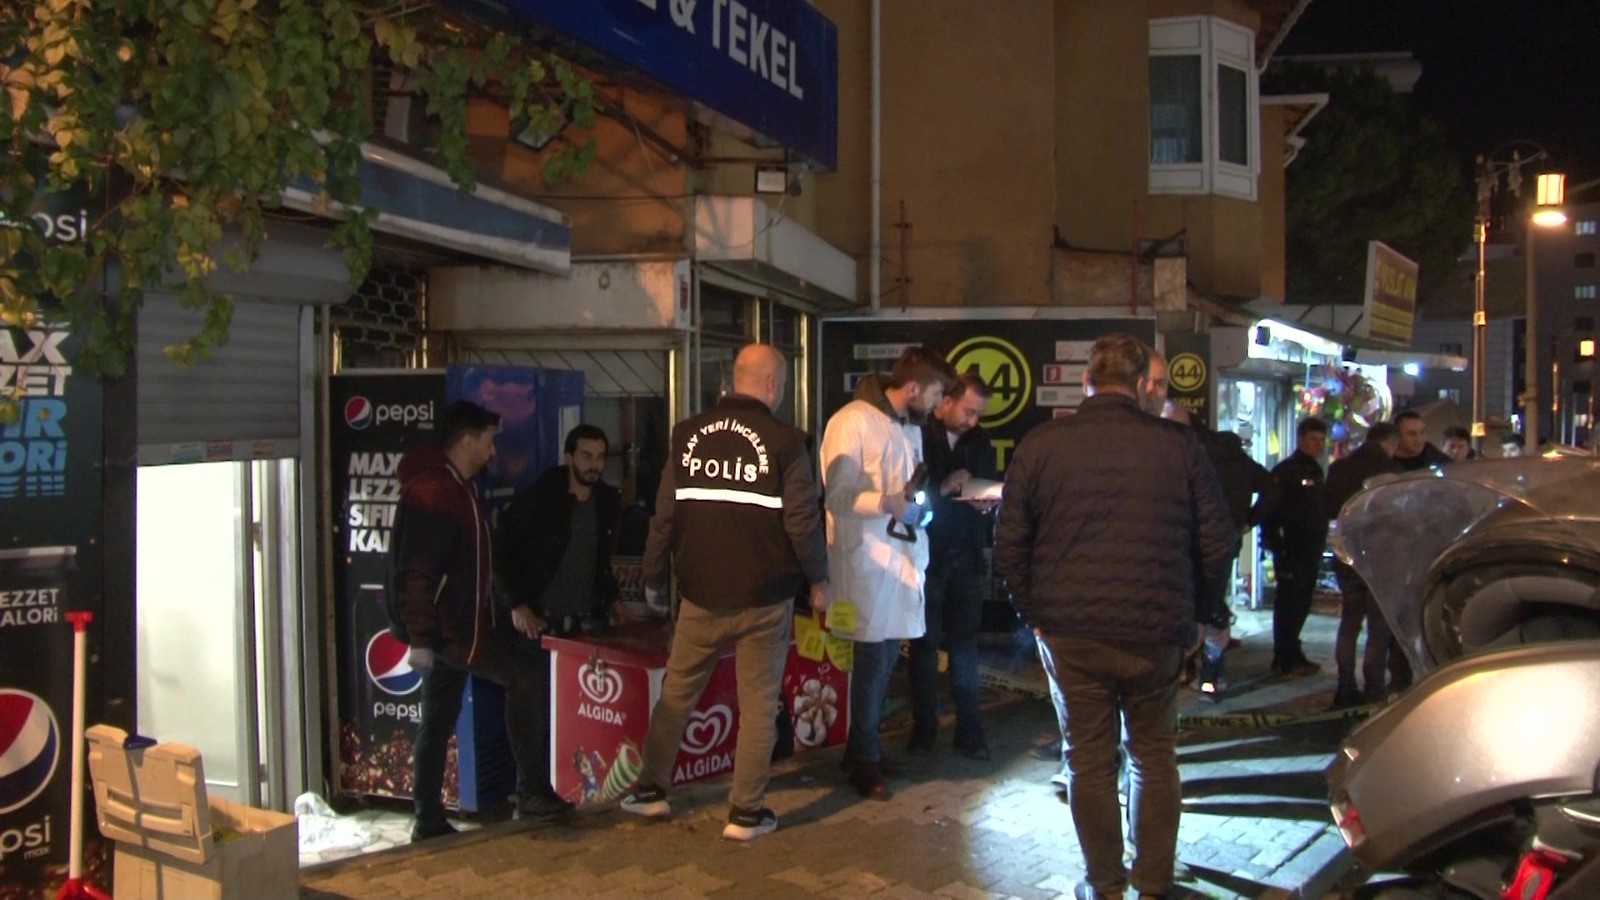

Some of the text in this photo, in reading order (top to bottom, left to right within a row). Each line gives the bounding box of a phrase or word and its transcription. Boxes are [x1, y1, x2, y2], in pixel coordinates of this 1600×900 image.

[712, 0, 804, 100] TEKEL
[1174, 363, 1201, 380] 44
[376, 399, 434, 426] pepsi
[682, 434, 698, 467] OLAY
[348, 452, 404, 476] MAX
[373, 701, 422, 721] pepsi
[24, 846, 50, 860] max
